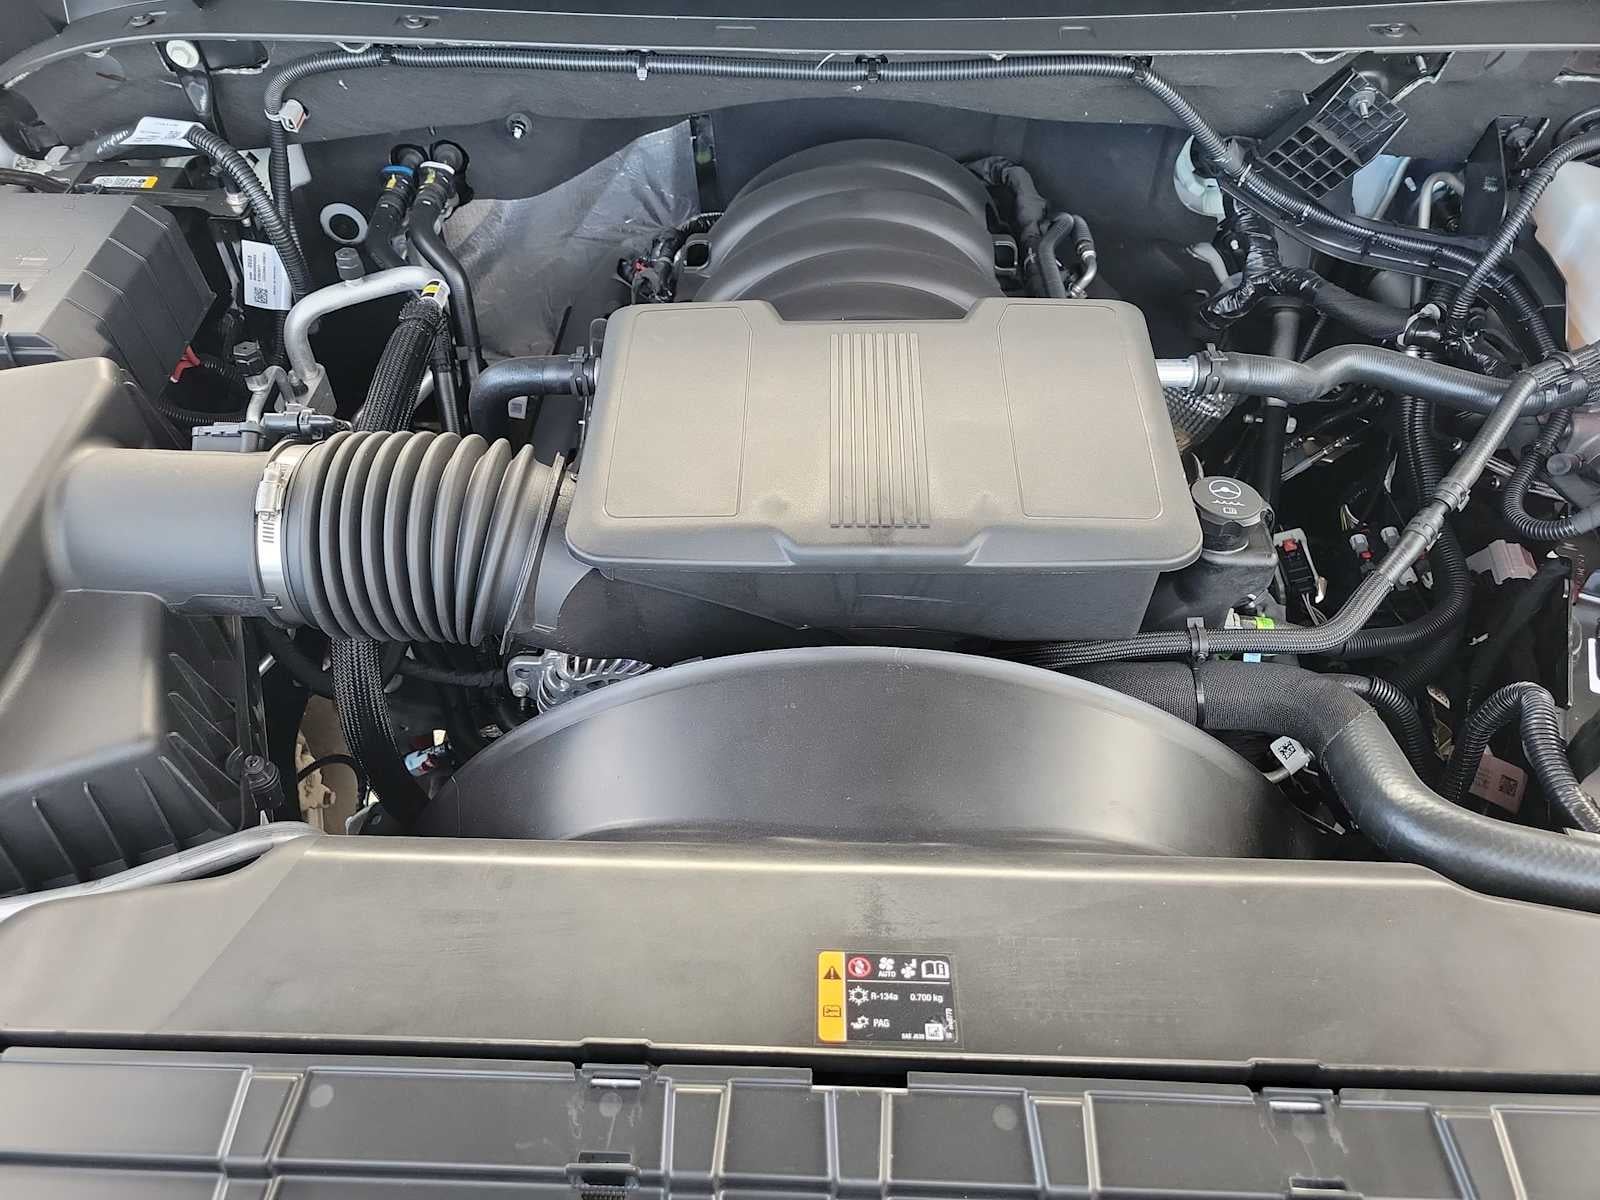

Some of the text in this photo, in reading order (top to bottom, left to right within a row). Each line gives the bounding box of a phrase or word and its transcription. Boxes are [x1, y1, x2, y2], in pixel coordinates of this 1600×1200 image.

[878, 970, 896, 978] AUTO
[870, 992, 943, 1004] R-134a 0.700 kg
[873, 1018, 890, 1027] PAG
